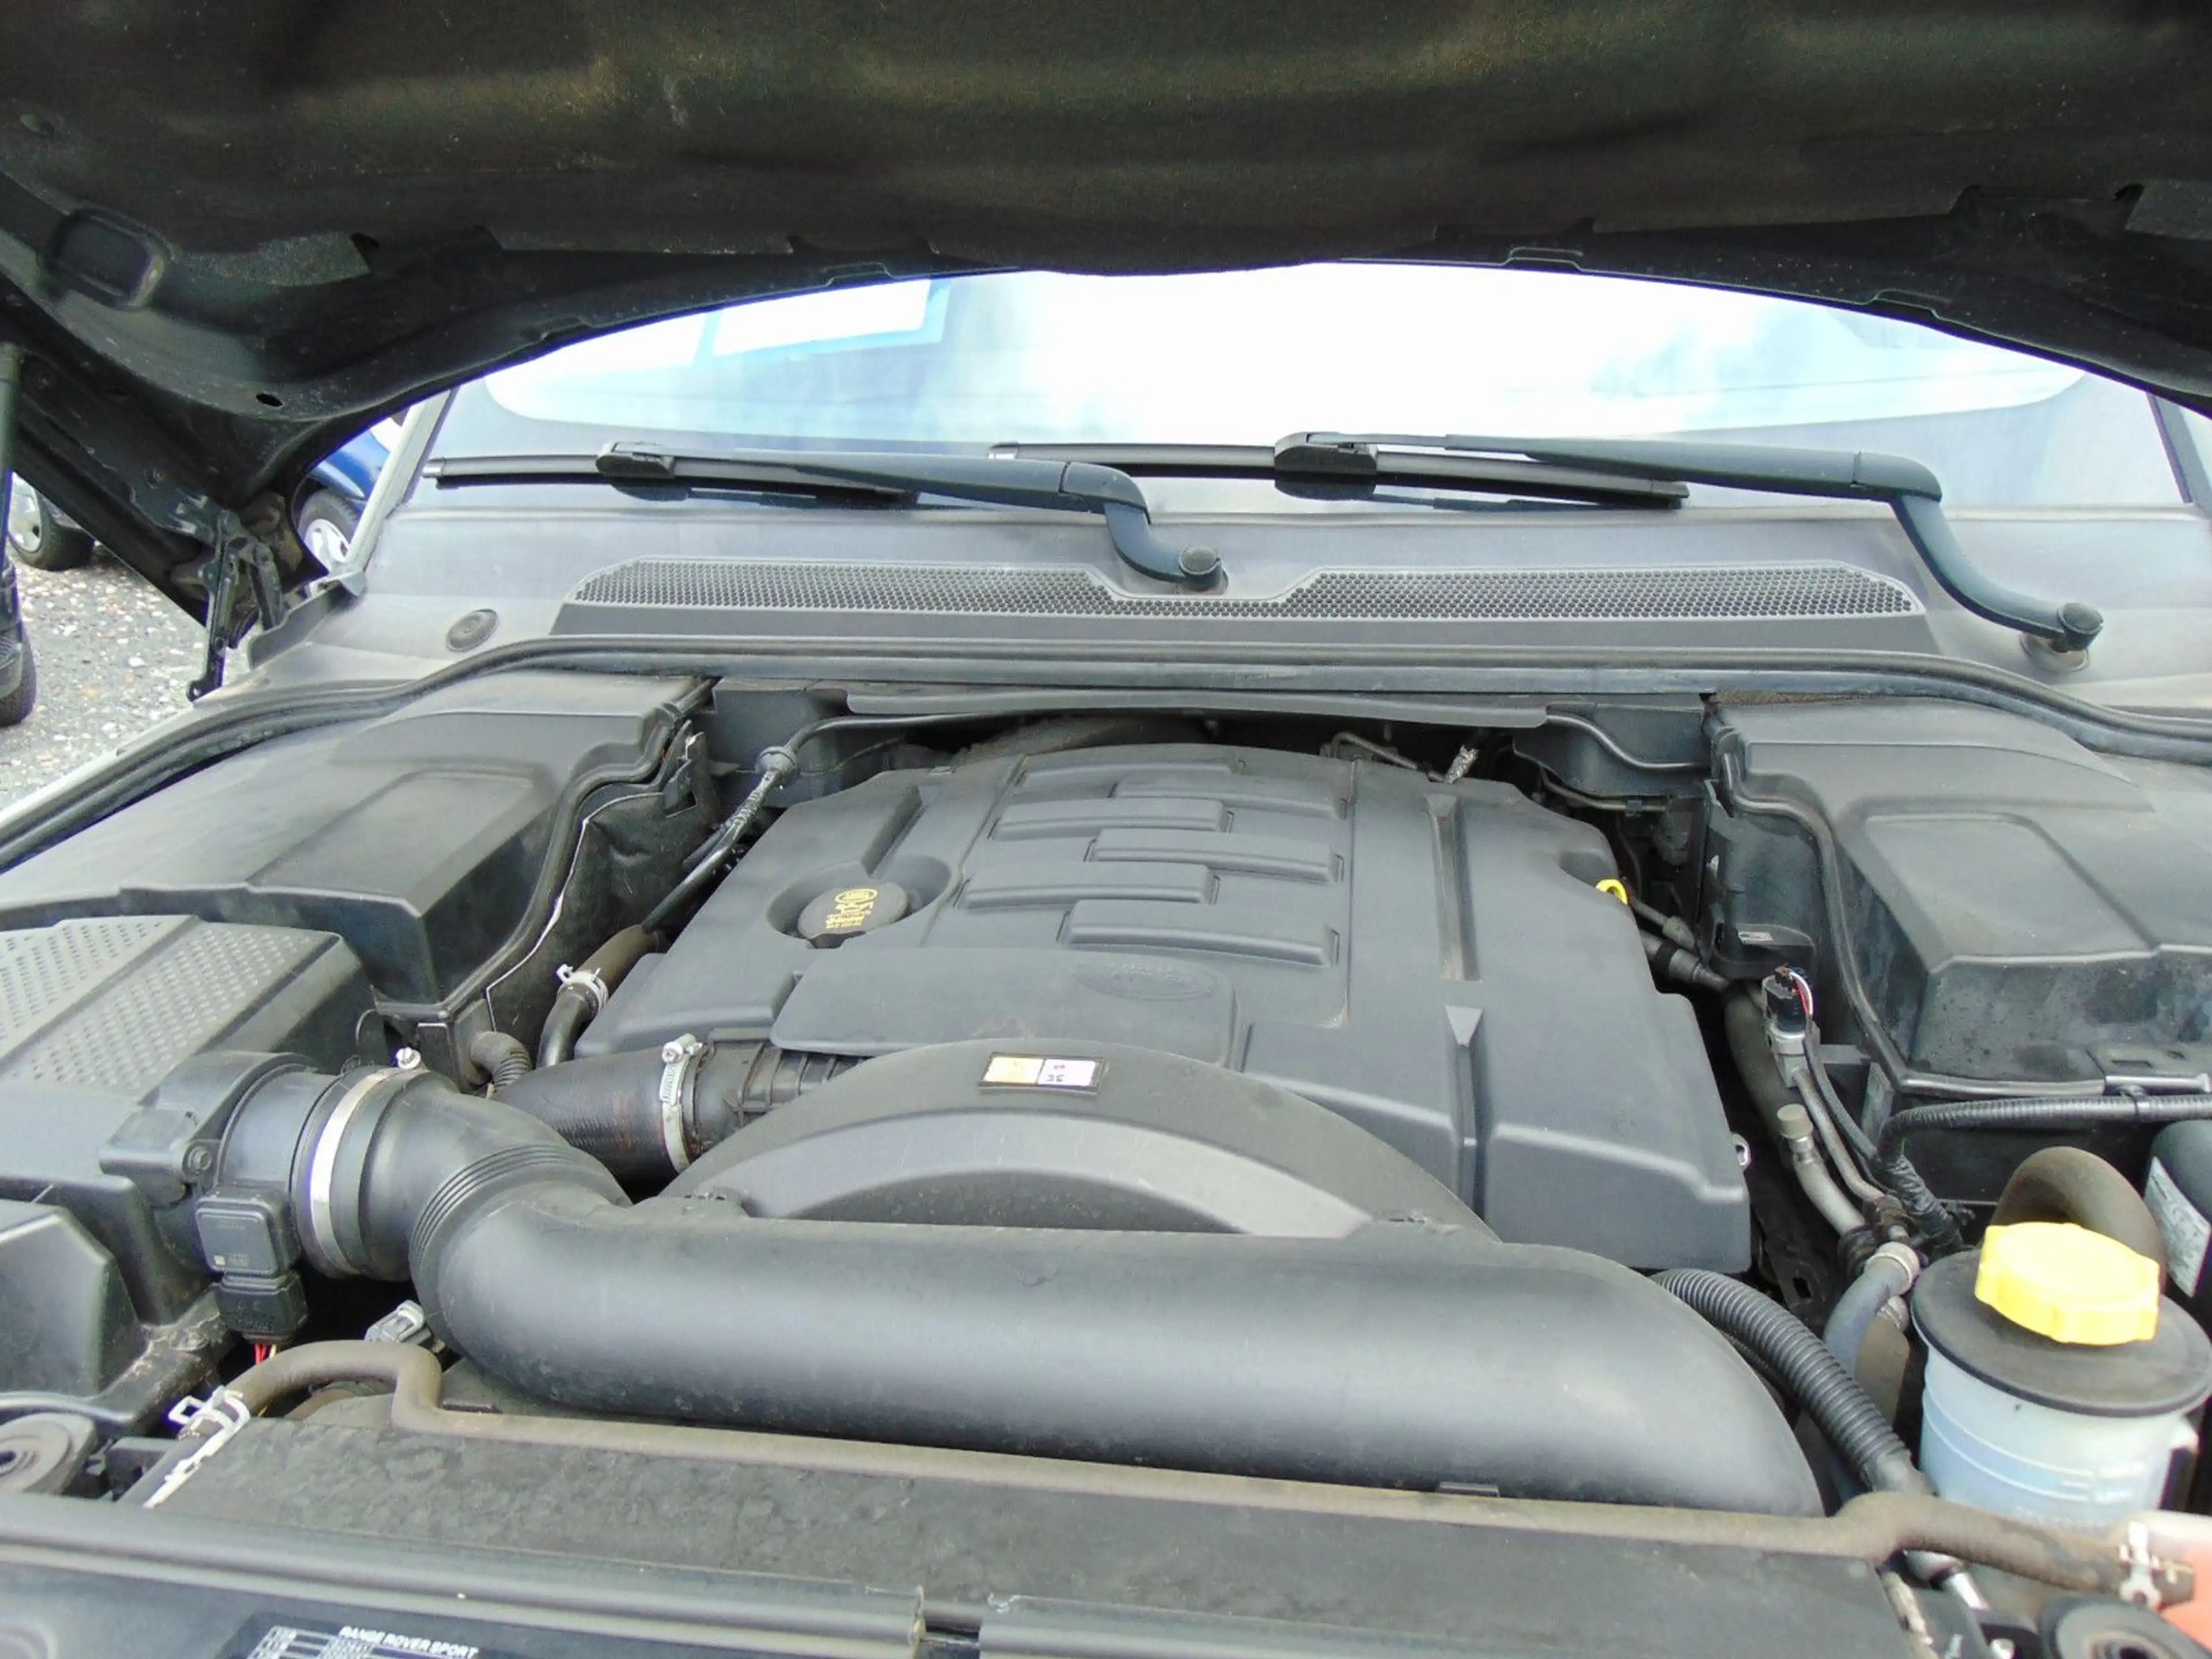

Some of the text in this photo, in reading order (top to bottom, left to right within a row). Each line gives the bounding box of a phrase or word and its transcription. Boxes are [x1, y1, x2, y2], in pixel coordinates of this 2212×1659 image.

[339, 1626, 385, 1644] RANGE
[382, 1633, 431, 1652] ROVER
[429, 1641, 479, 1659] SPORT
